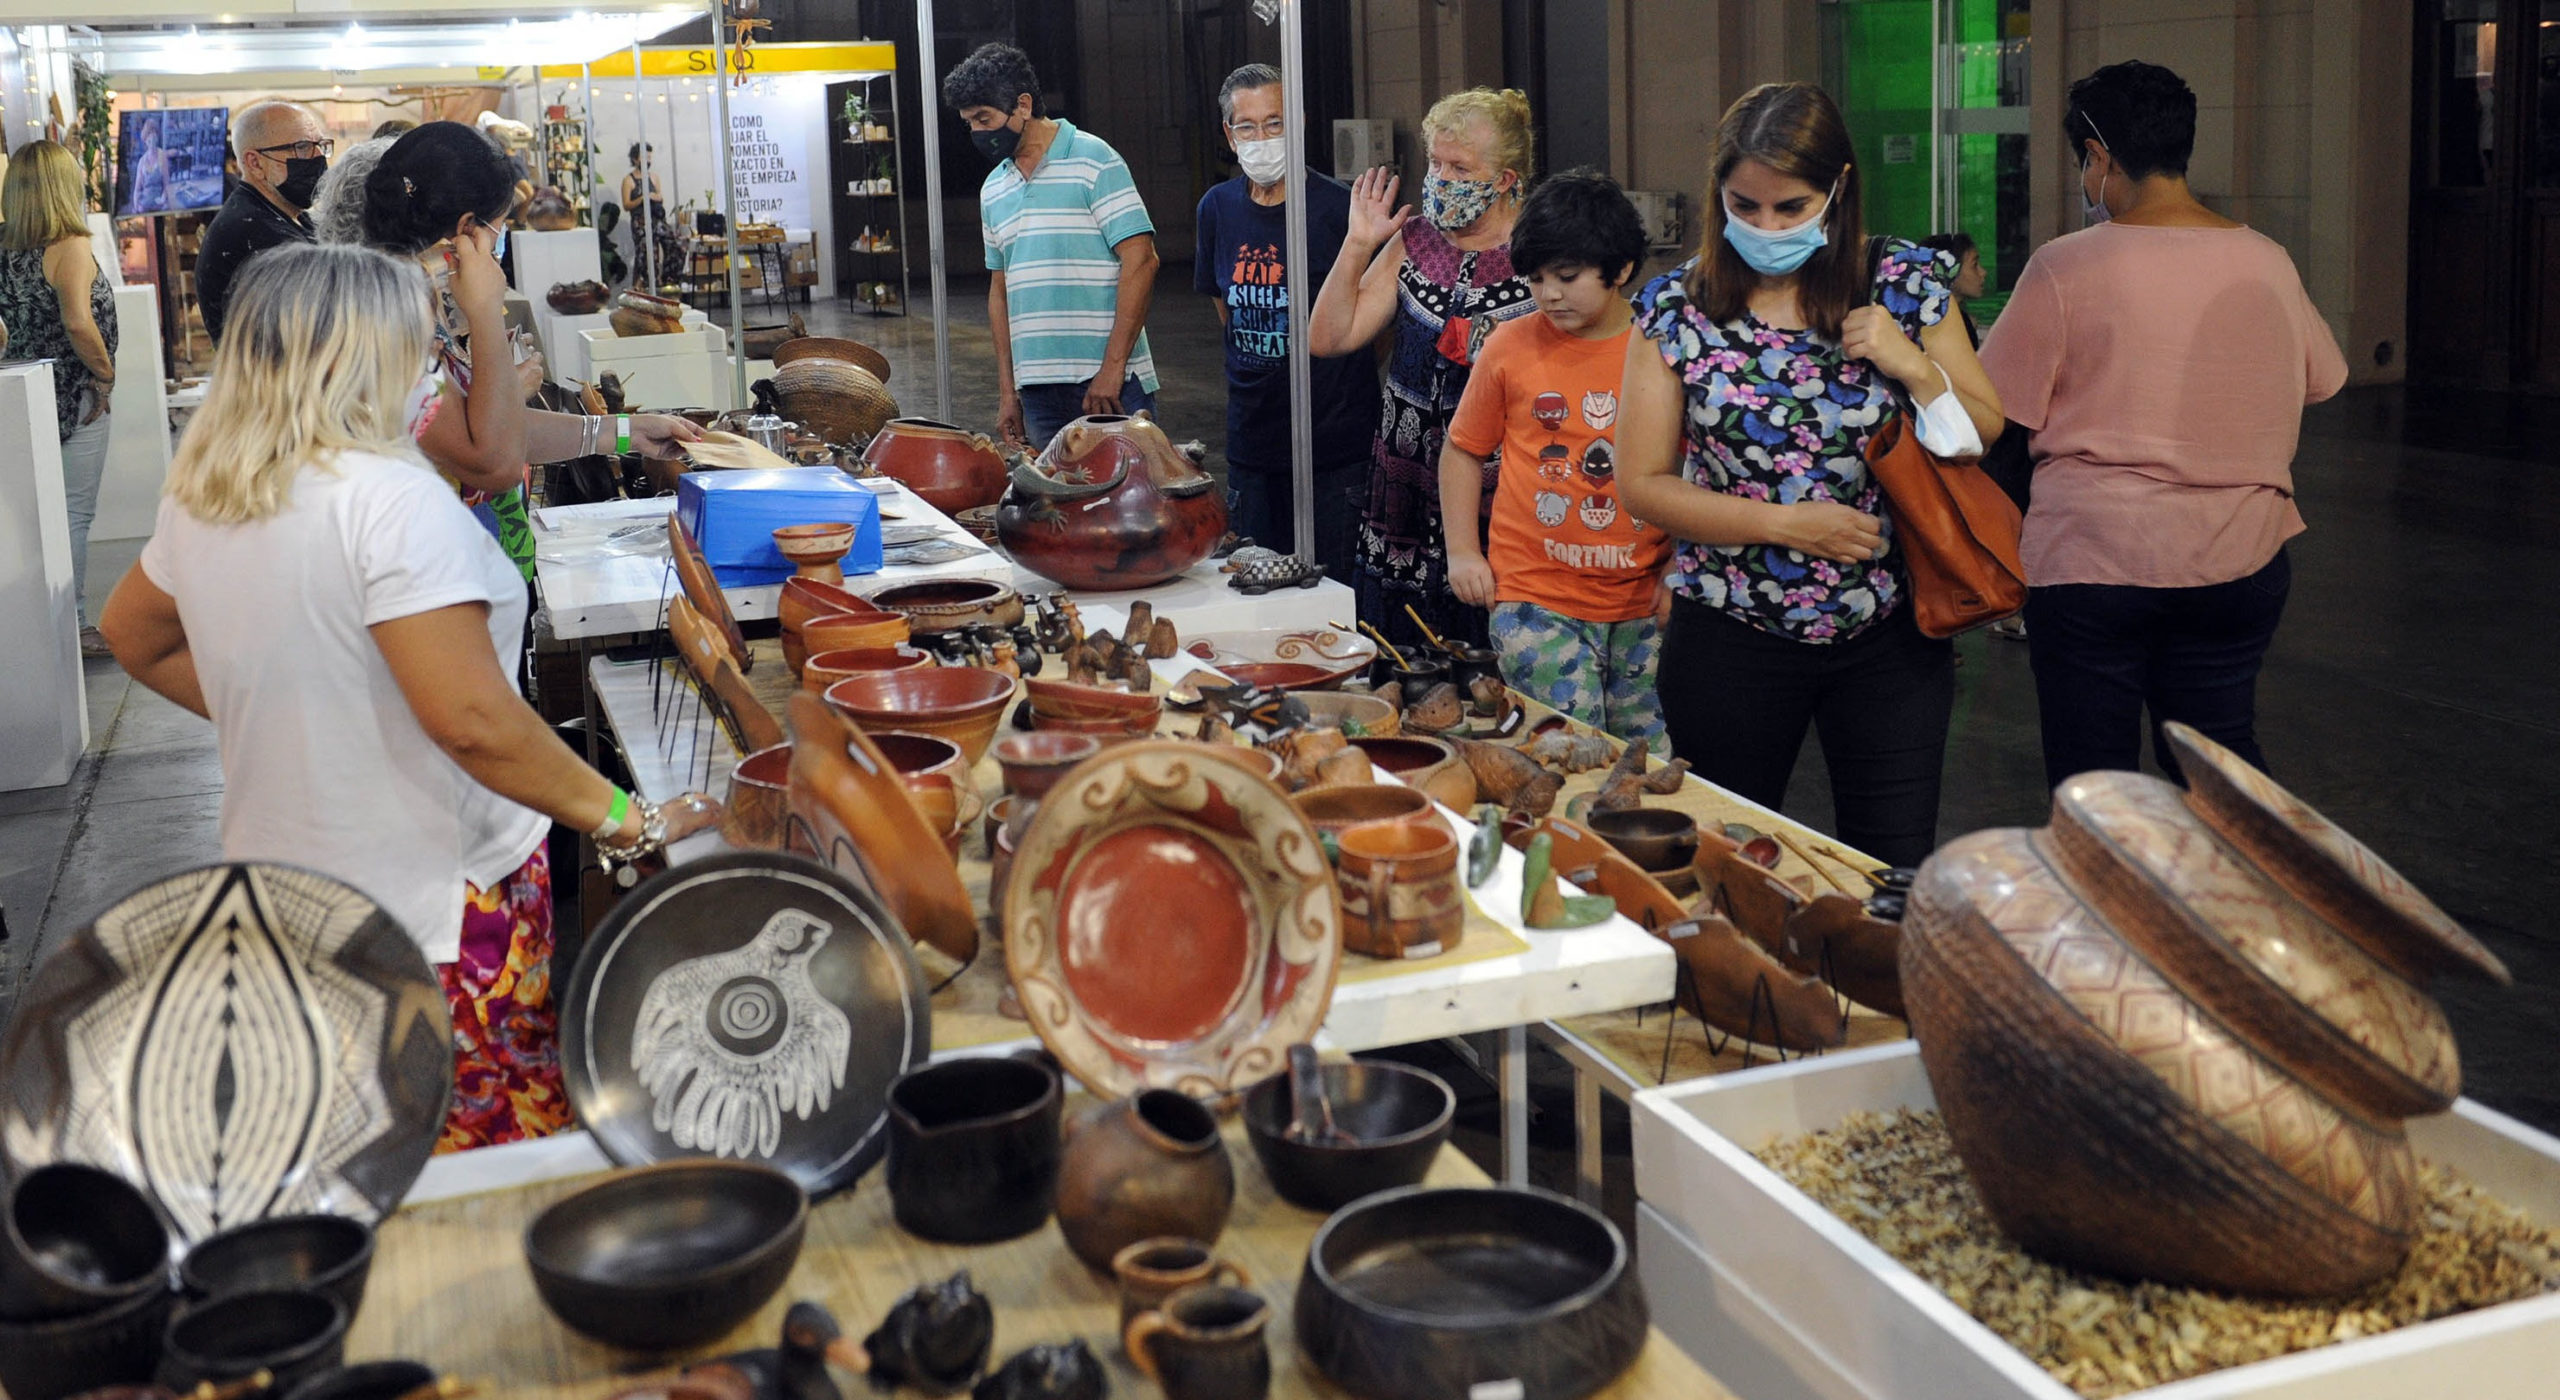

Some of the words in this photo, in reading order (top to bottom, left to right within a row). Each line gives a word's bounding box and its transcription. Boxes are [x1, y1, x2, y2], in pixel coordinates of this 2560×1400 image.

[729, 115, 763, 129] COMO
[731, 130, 753, 143] IJAR
[756, 130, 769, 142] EL
[733, 158, 767, 171] XACTO
[770, 157, 784, 169] EN
[734, 172, 748, 185] UE
[751, 170, 797, 184] EMPIEZA
[735, 186, 750, 199] NA
[737, 198, 783, 213] ISTORIA?
[1242, 261, 1274, 285] EAT
[1236, 285, 1282, 309] SLEEP
[1240, 308, 1280, 331] SURF
[1235, 330, 1290, 356] REPEAT
[1543, 538, 1638, 569] FORTNITE
